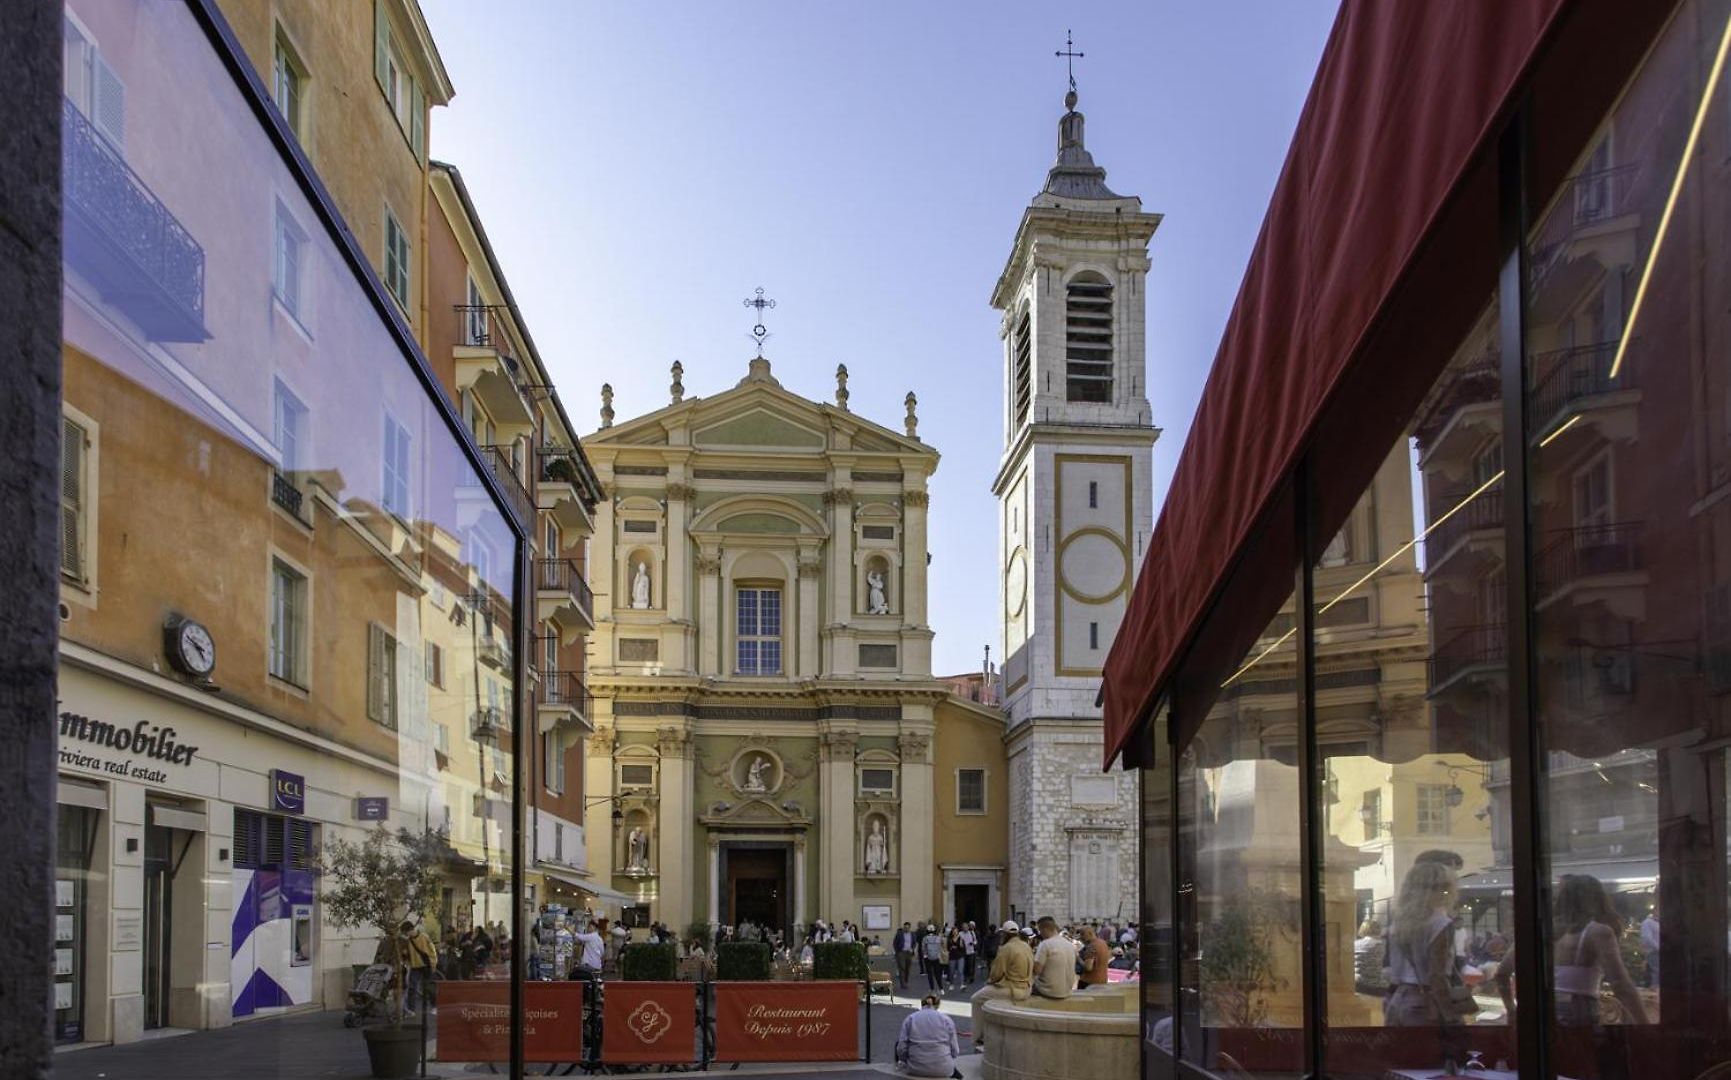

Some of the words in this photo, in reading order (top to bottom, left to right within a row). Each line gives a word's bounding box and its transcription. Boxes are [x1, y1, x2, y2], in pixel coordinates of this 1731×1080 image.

[57, 706, 199, 766] mmobilier
[104, 760, 132, 775] real
[131, 770, 167, 783] estate
[278, 779, 303, 796] LCL
[747, 1004, 826, 1018] Restaurant
[744, 1021, 793, 1039] Depuis
[796, 1022, 832, 1038] 1987
